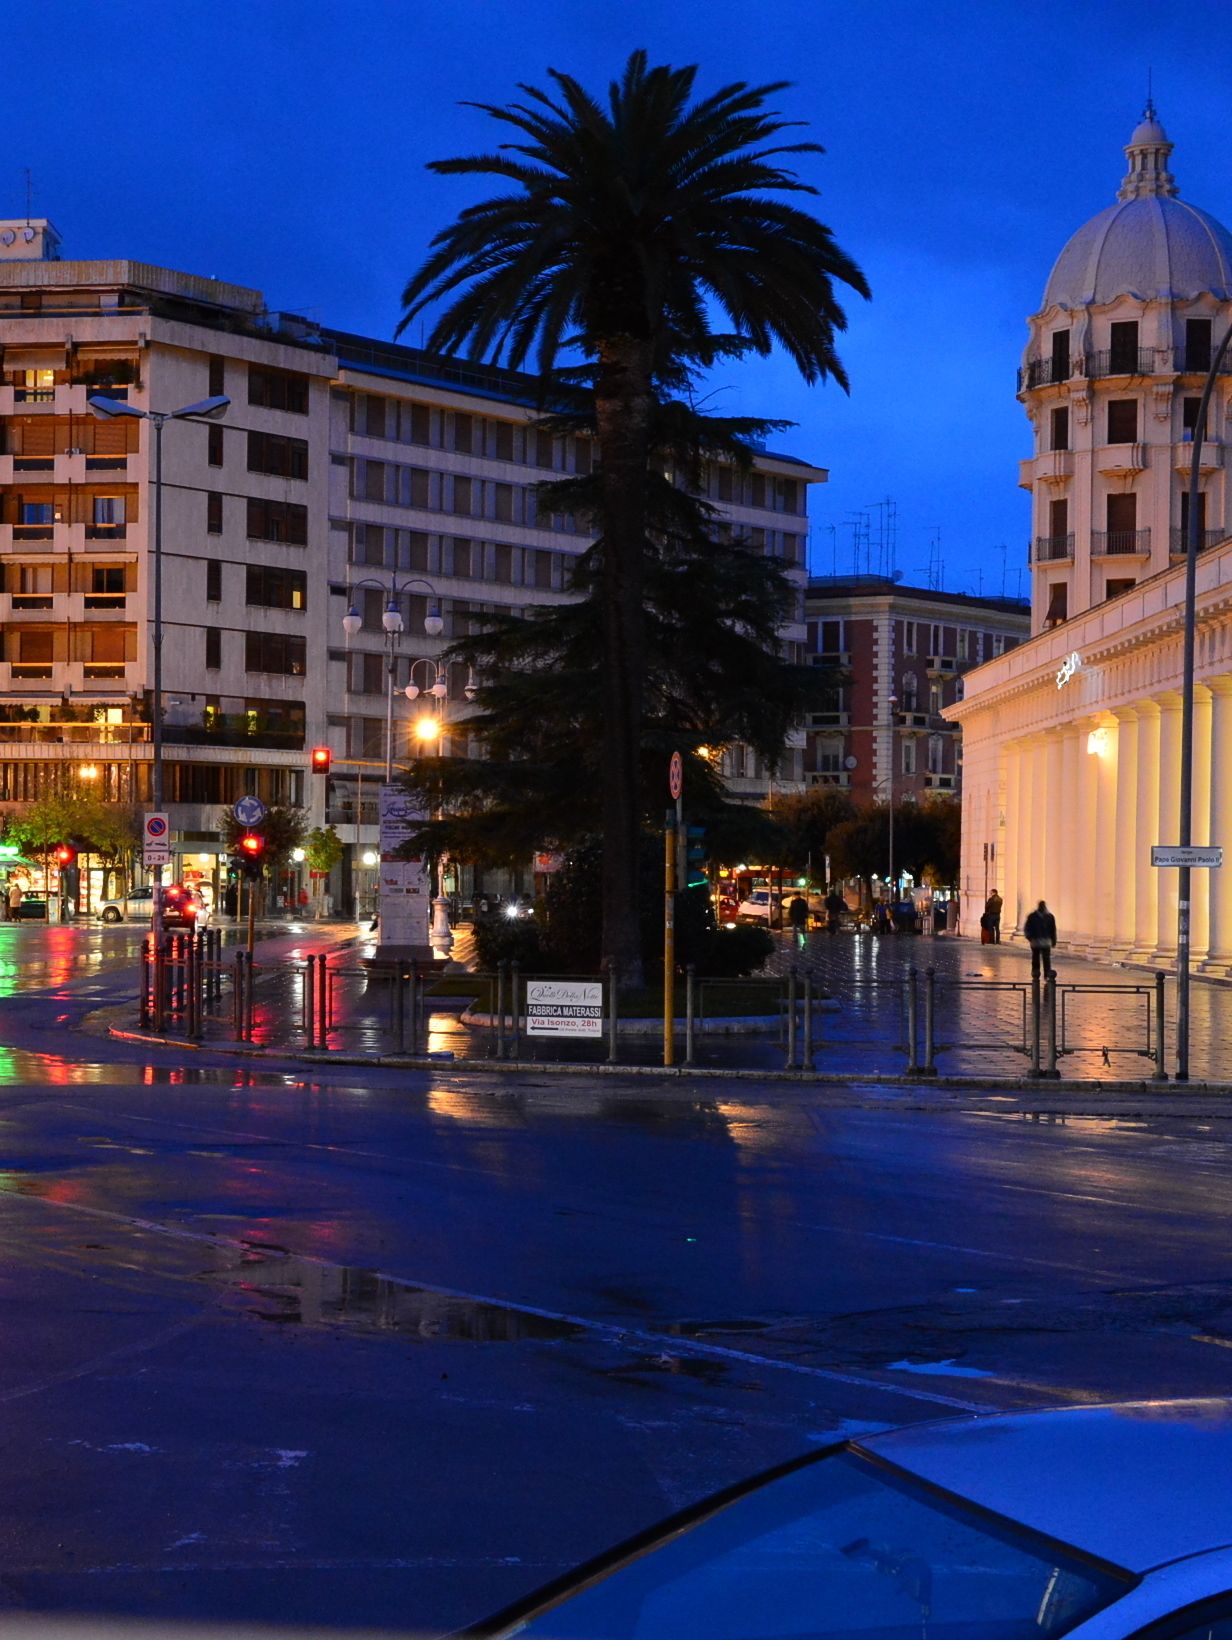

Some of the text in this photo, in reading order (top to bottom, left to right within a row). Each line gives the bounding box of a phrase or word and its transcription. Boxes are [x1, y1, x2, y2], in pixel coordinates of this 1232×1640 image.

[528, 1005, 601, 1017] FABBRICA MATERASSI
[547, 1019, 579, 1027] Isonzo,
[581, 1019, 597, 1027] 28h
